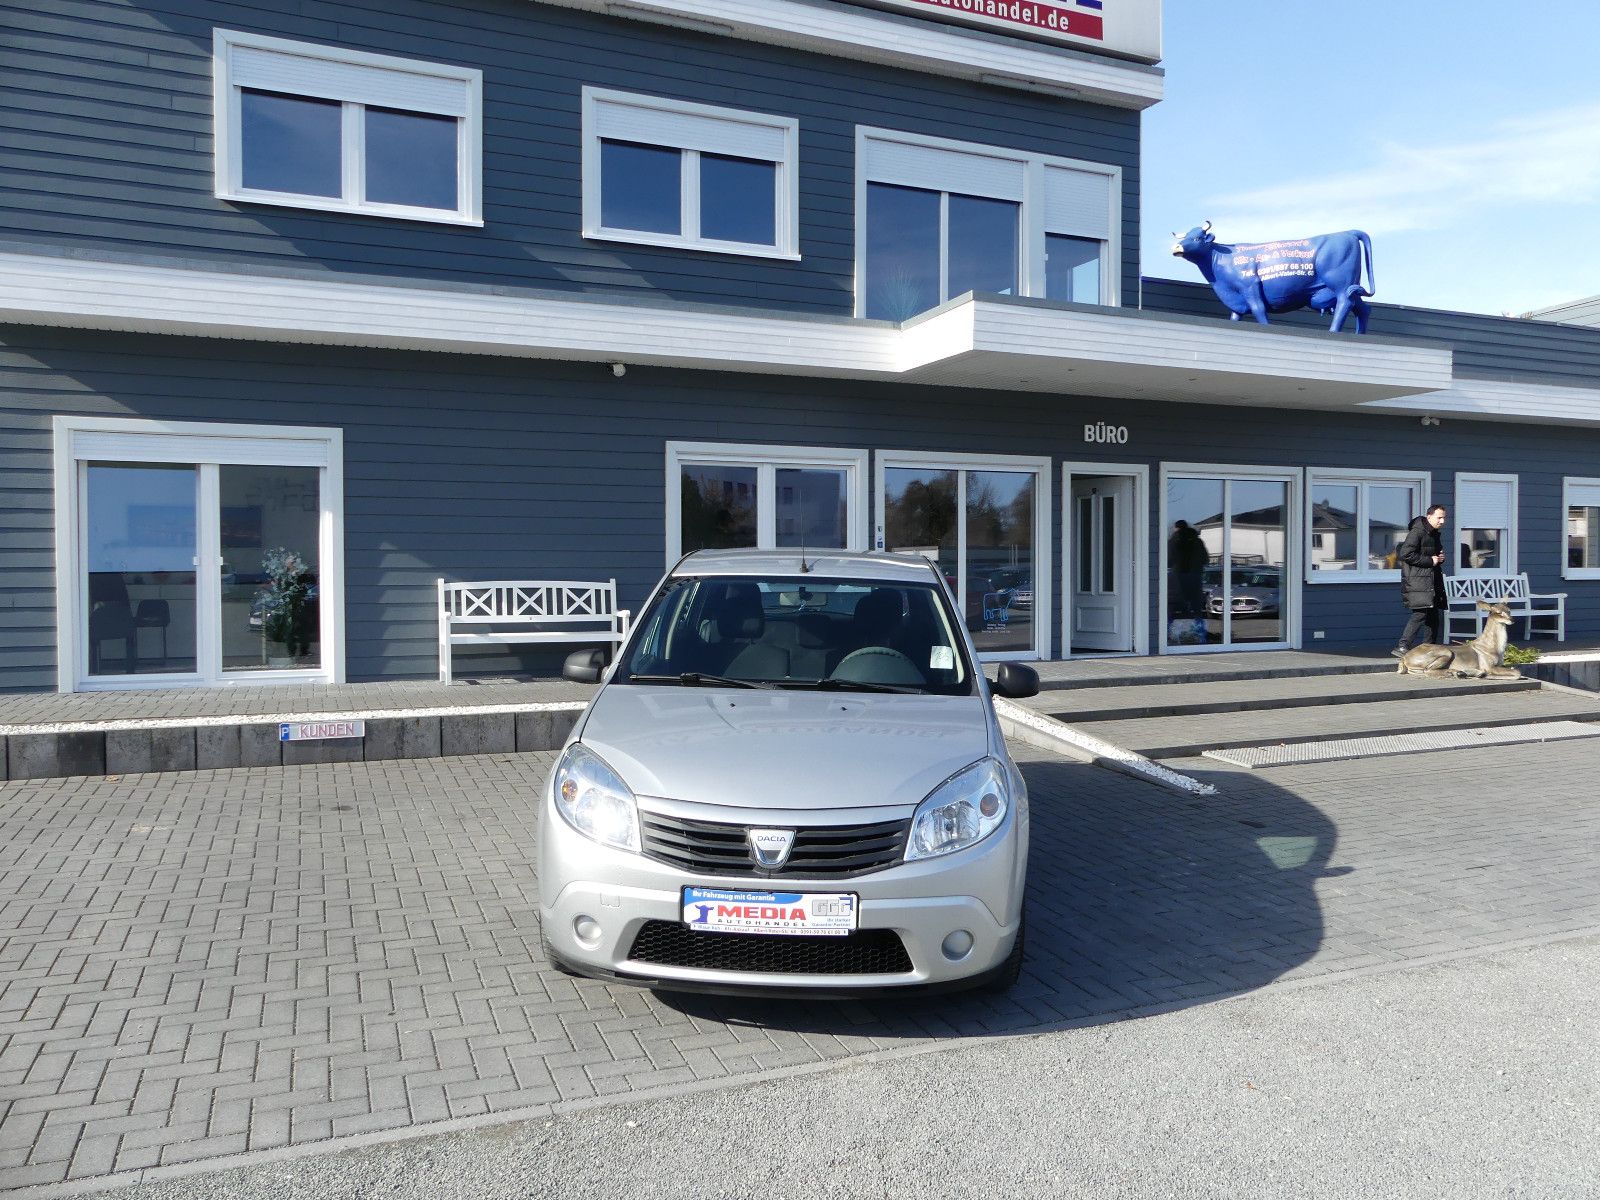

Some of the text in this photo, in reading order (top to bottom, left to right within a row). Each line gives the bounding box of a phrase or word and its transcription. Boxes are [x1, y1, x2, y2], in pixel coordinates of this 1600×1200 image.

[929, 0, 1069, 30] ohandel.de
[1084, 421, 1129, 444] BÜRO
[300, 722, 354, 738] KUNDEN
[757, 835, 787, 843] DACIA
[703, 891, 734, 900] Fahrzeug
[717, 905, 807, 921] MEDIA
[717, 918, 807, 927] AUTOHANDEL
